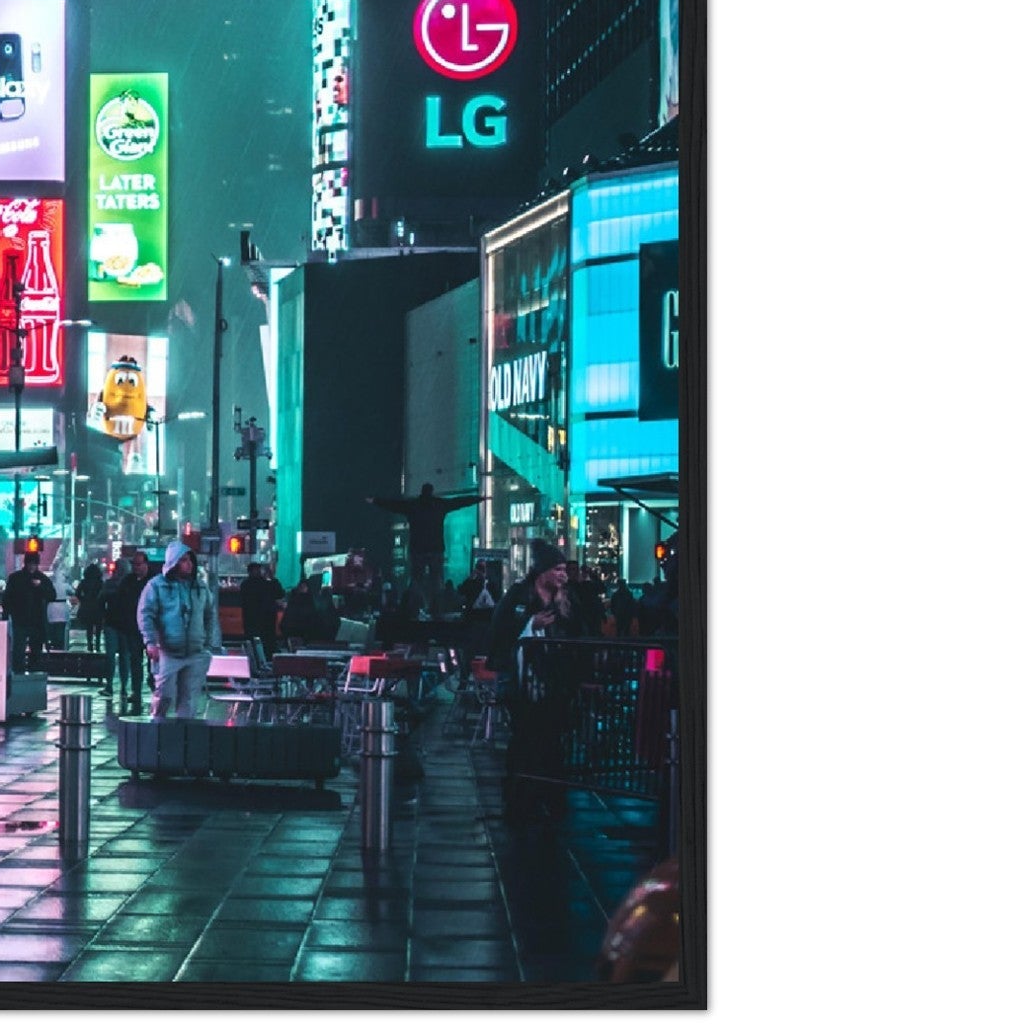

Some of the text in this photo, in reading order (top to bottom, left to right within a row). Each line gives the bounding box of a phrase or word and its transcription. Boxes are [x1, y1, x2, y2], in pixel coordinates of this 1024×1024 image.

[426, 95, 507, 148] LG
[99, 174, 155, 191] LATER
[95, 193, 160, 210] TATERS
[491, 350, 547, 411] OLD NAVY
